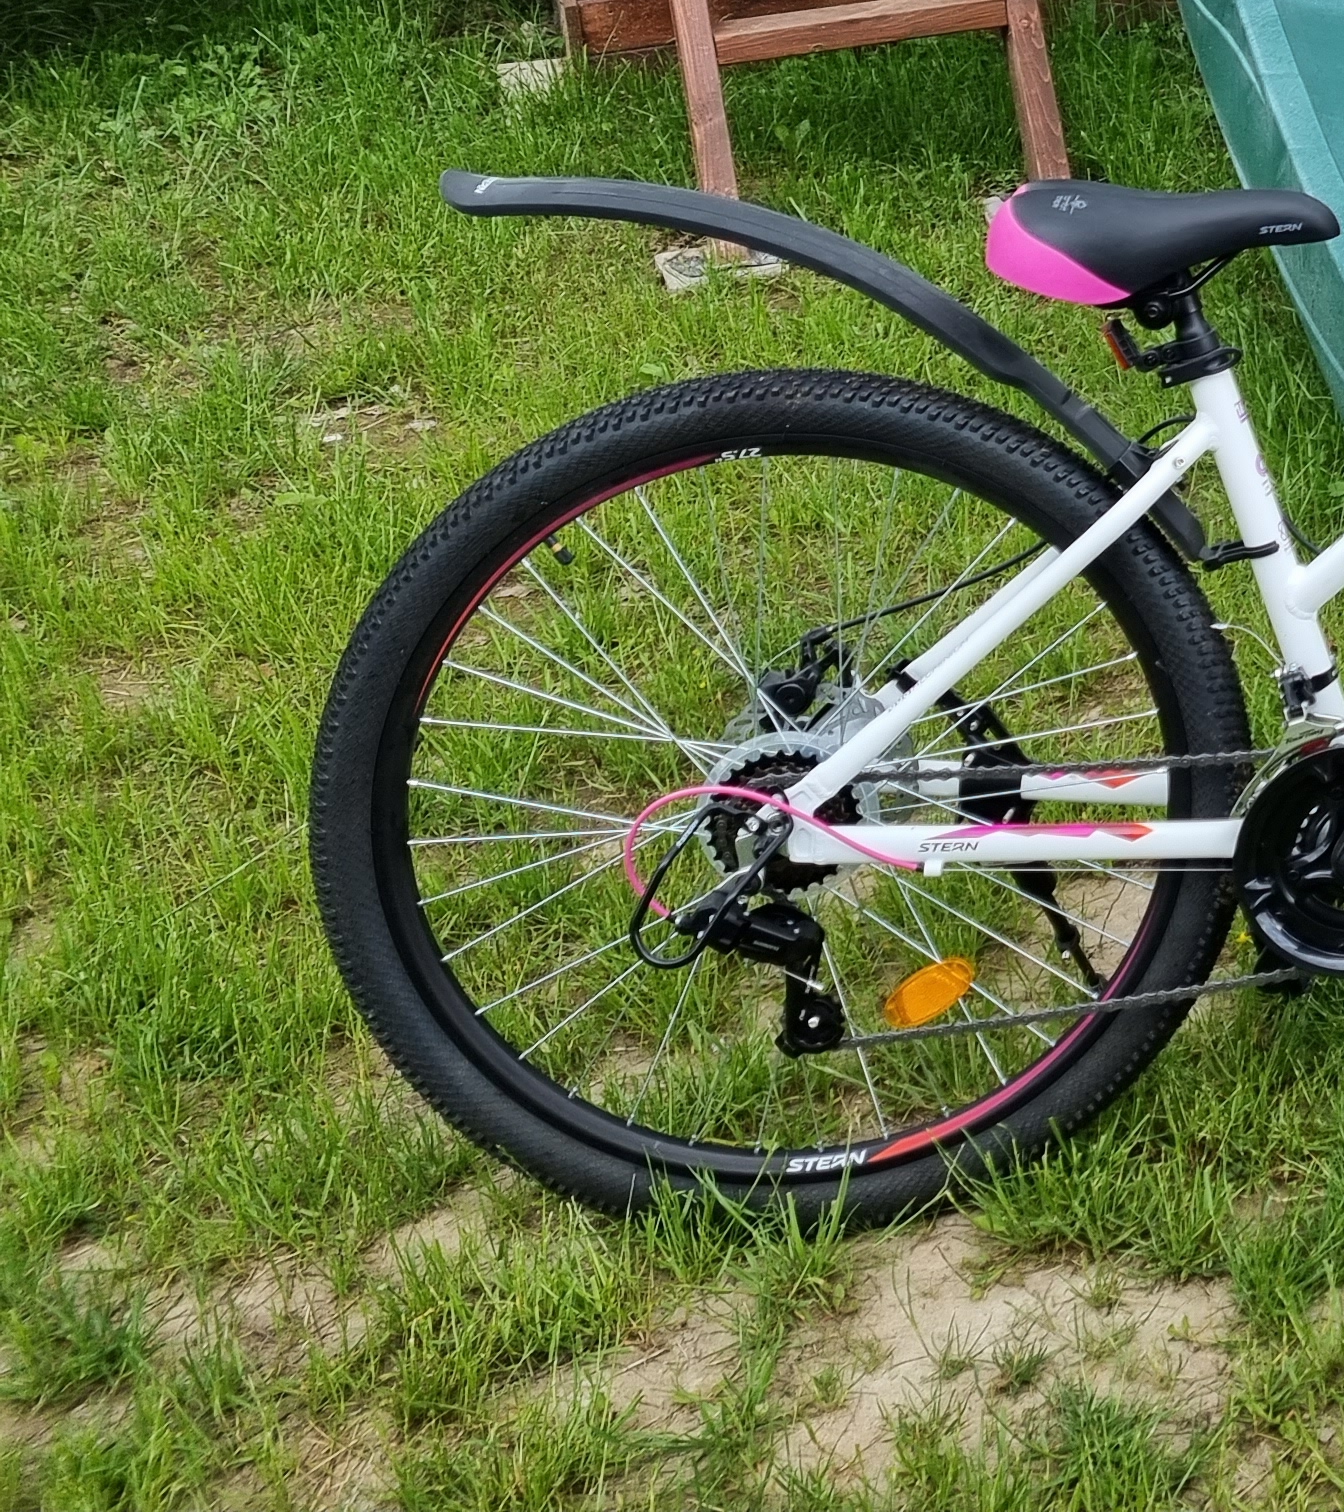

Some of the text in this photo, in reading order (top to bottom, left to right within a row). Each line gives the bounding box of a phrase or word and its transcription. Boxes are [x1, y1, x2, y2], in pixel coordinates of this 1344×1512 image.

[1257, 222, 1304, 236] STERN
[917, 841, 980, 853] STERN
[785, 1149, 867, 1173] STERN
